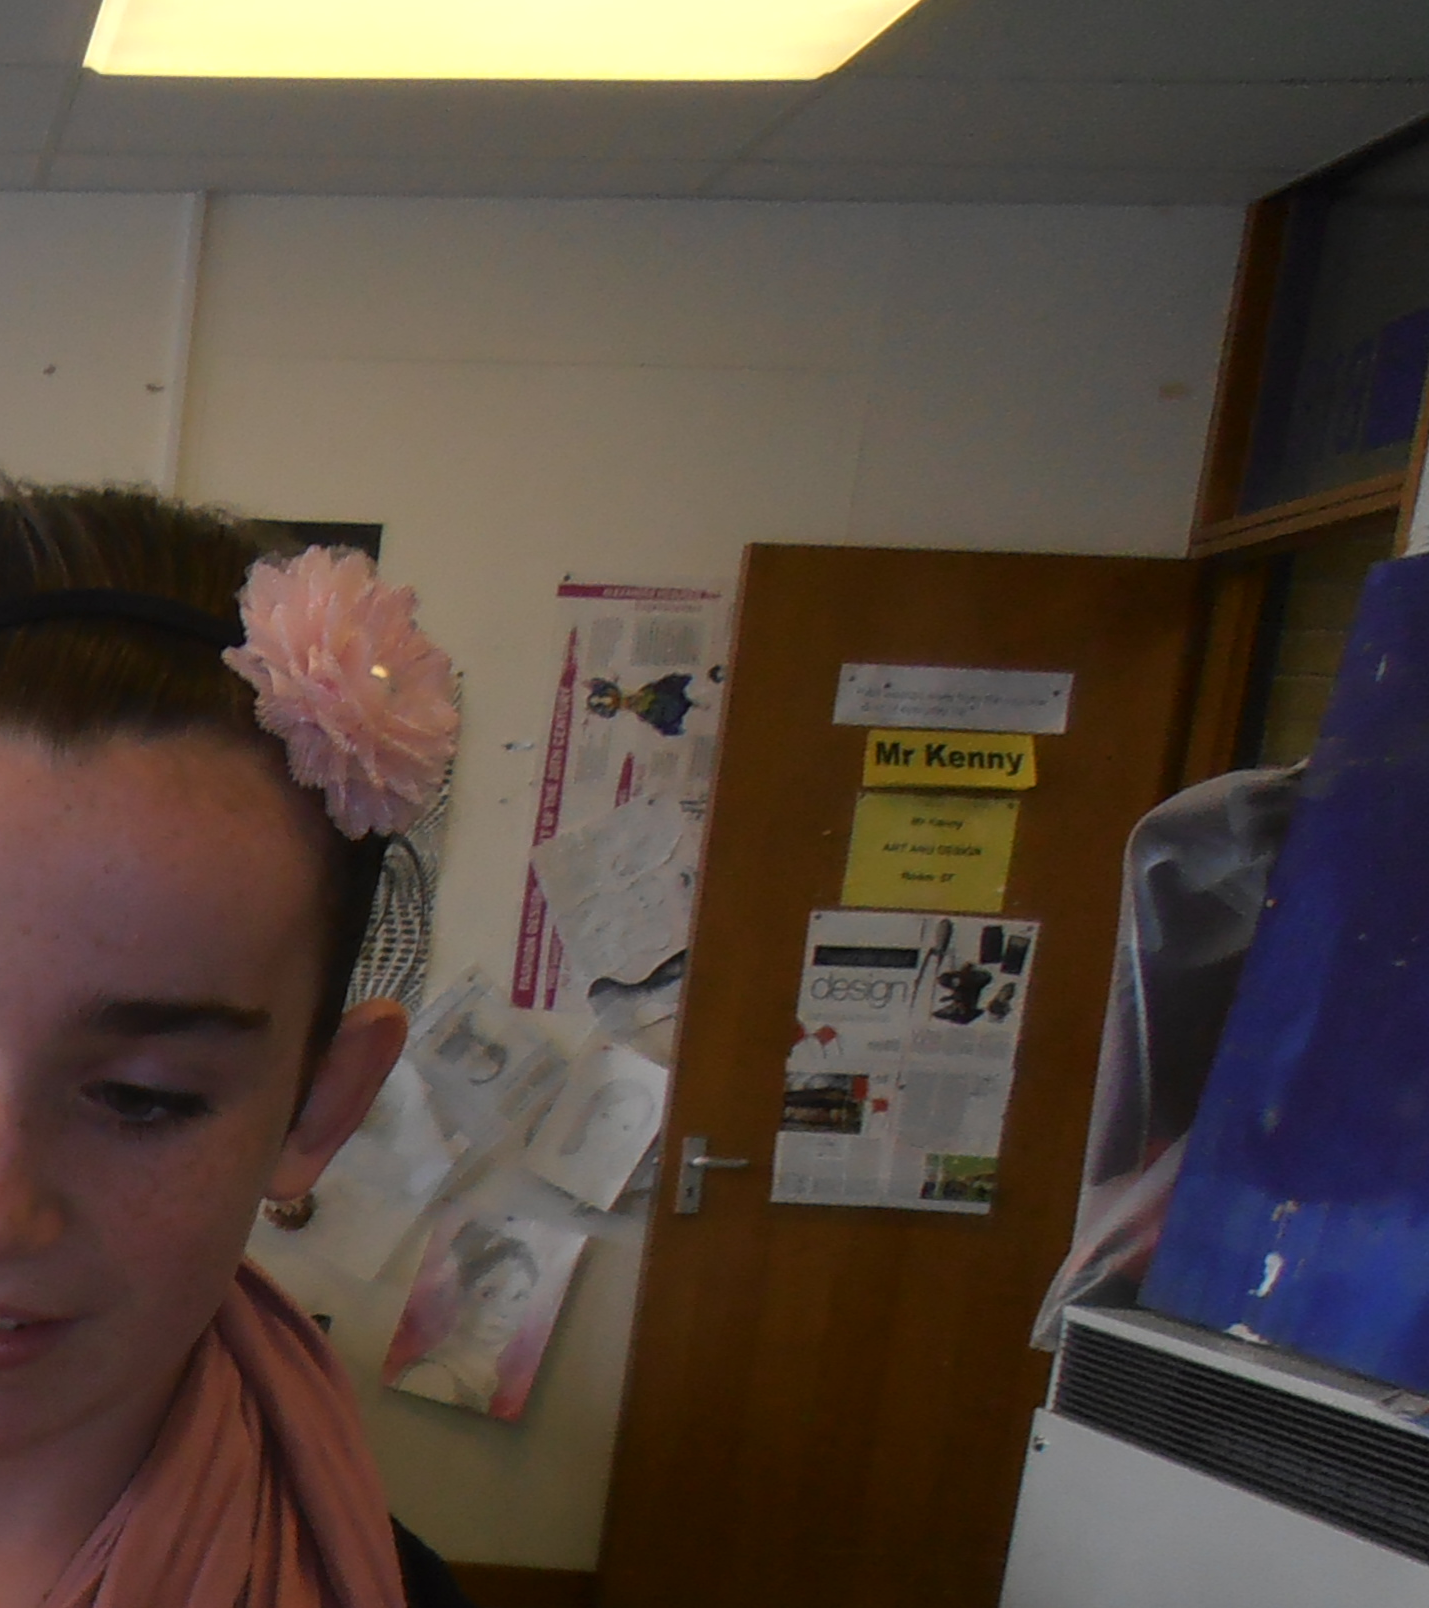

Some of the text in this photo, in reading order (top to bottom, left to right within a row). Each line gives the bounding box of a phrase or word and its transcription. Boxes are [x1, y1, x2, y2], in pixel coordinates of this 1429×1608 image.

[551, 685, 574, 747] CENTURY
[876, 741, 1024, 776] Mr Kenny
[517, 936, 537, 991] FASHION
[810, 971, 910, 1010] design
